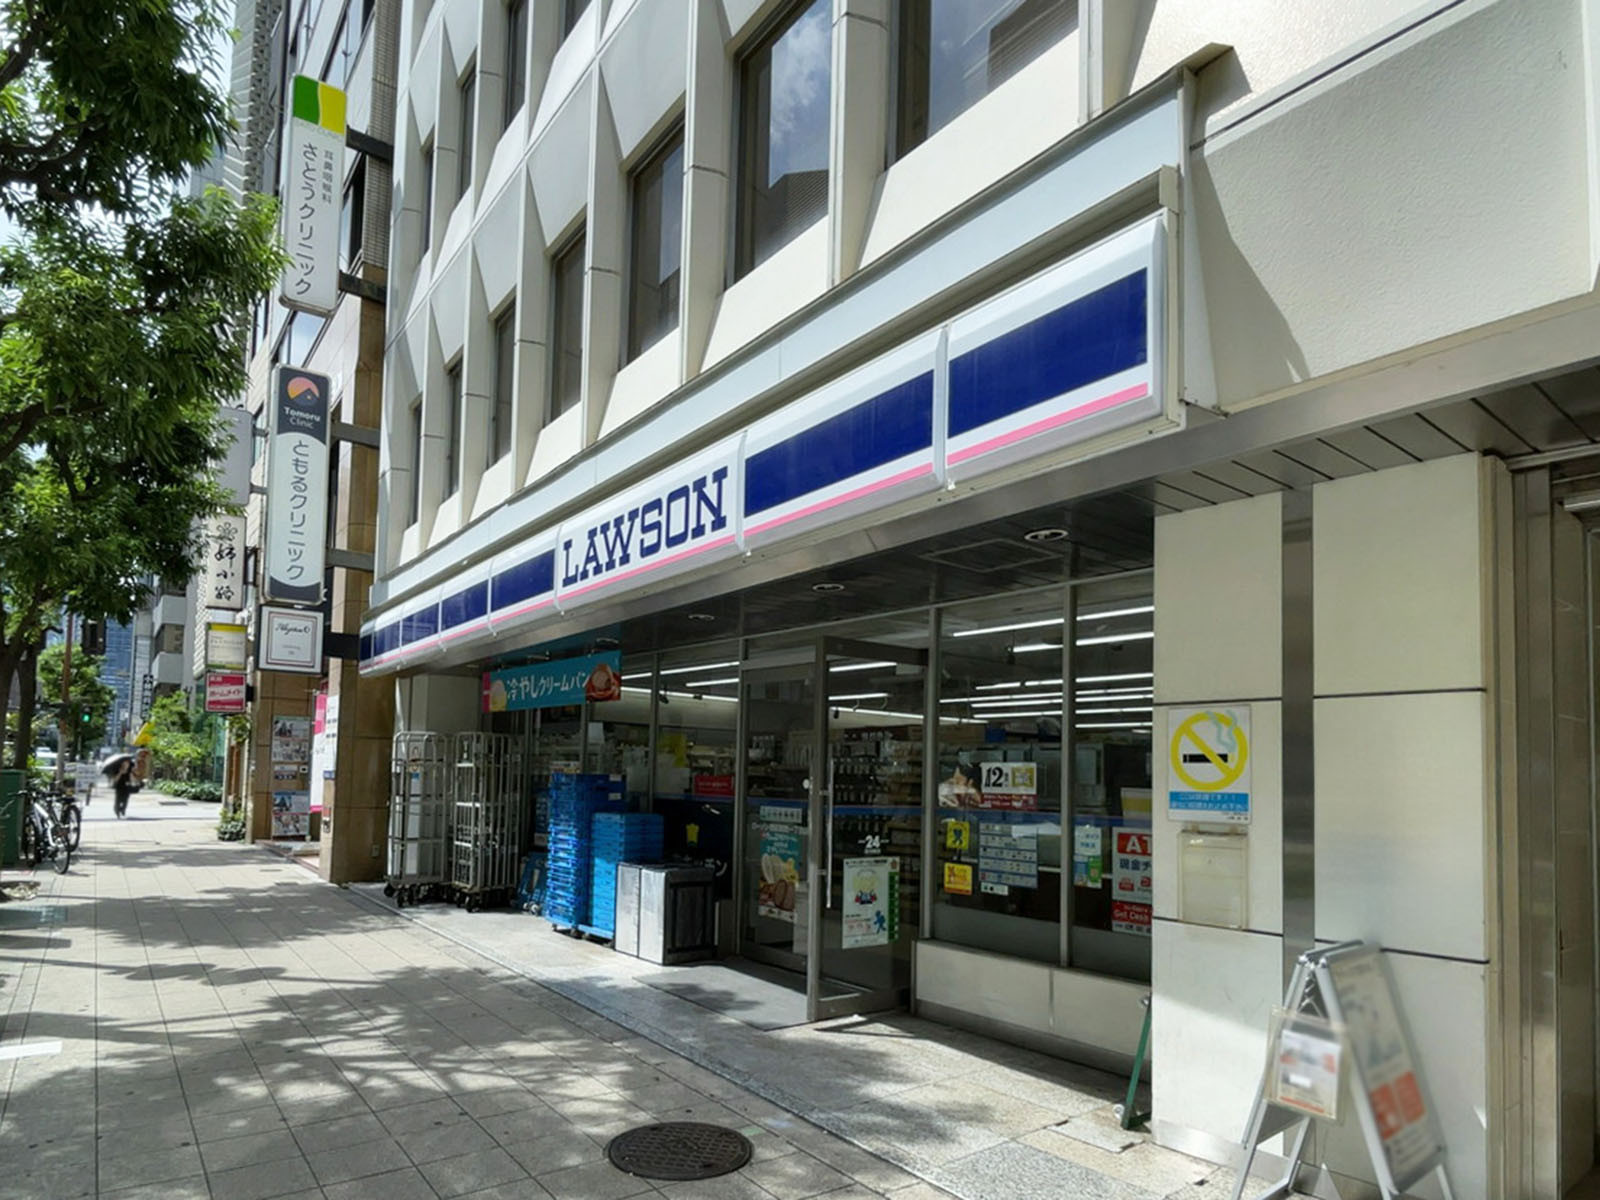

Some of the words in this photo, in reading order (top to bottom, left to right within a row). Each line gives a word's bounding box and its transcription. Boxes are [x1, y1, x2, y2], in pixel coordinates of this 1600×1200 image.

[295, 142, 318, 294] さとうクリニック
[283, 406, 321, 423] Tomoru
[289, 417, 314, 430] Clinic
[286, 439, 310, 580] ともるクリニック
[562, 465, 728, 588] LAWSON
[984, 766, 1004, 788] 12
[865, 834, 881, 849] 24
